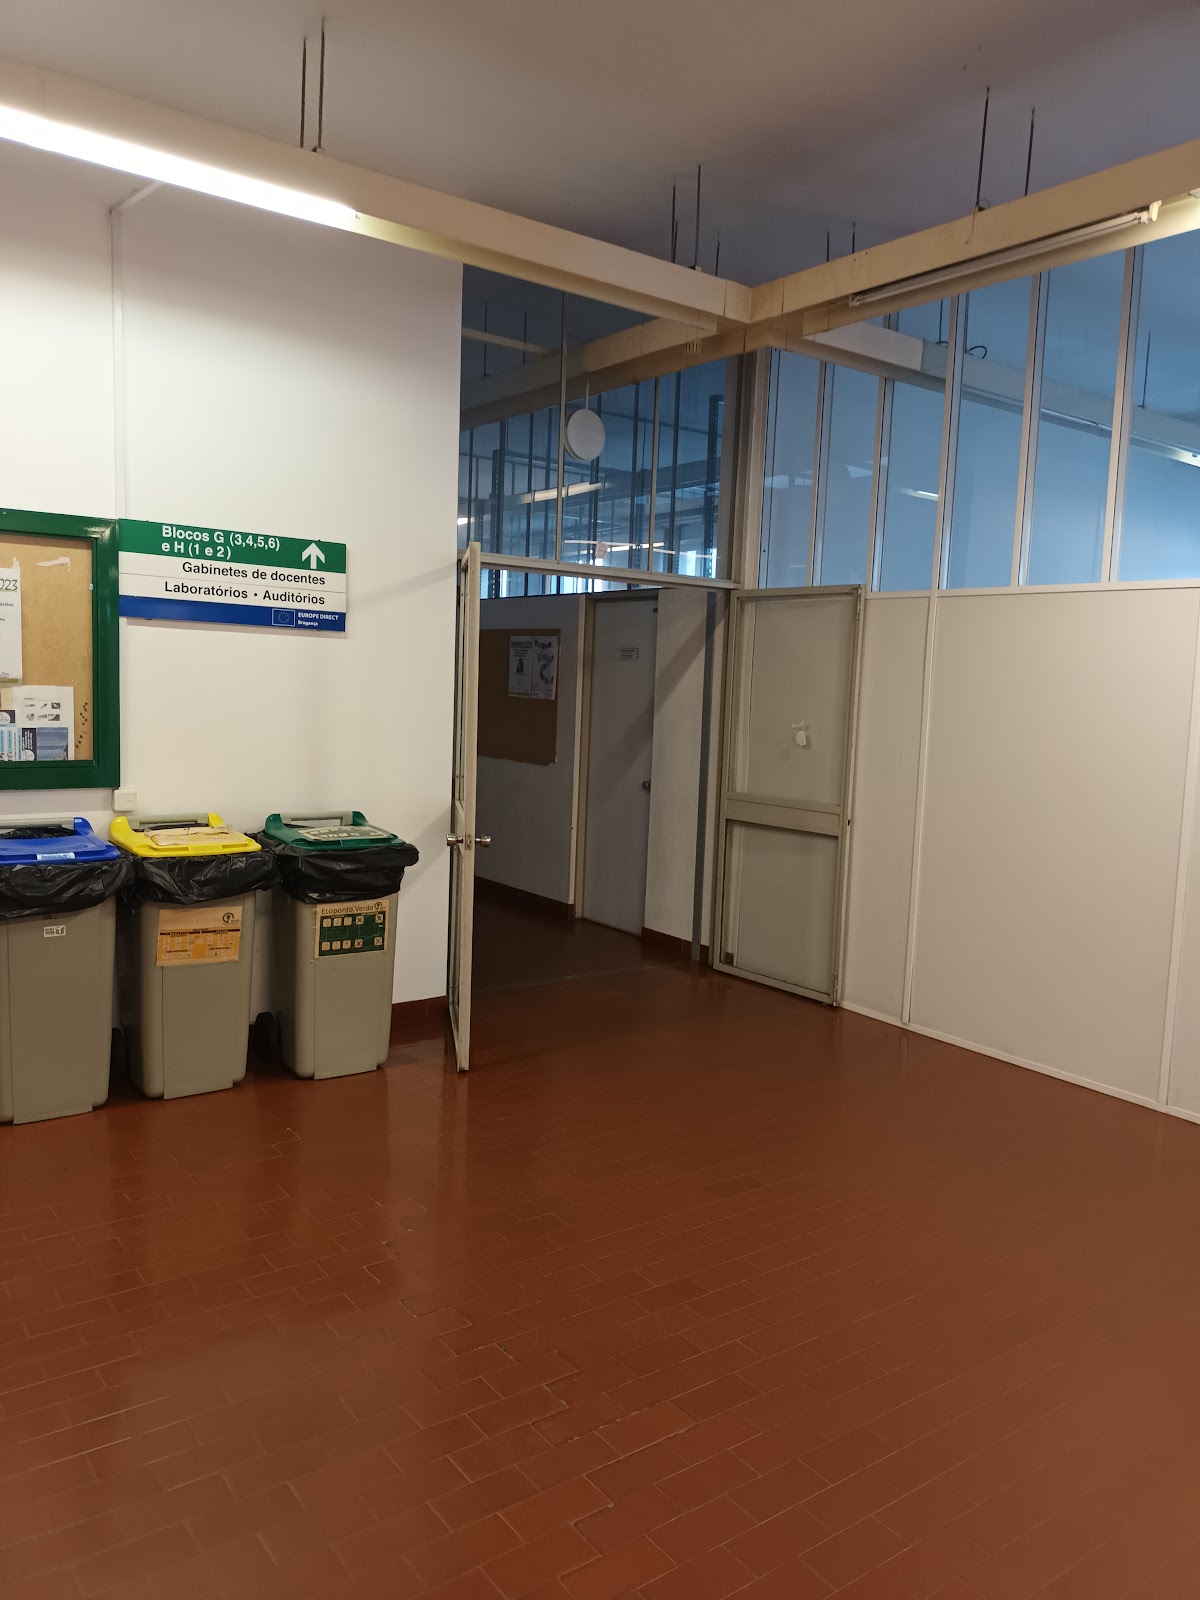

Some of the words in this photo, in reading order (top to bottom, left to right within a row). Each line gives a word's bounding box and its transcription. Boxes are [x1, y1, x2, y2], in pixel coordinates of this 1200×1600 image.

[162, 525, 209, 542] Blocos
[214, 531, 224, 543] G
[230, 532, 280, 552] (3,4,5,6)
[161, 542, 170, 552] e
[174, 541, 184, 553] H
[204, 546, 213, 556] e
[182, 561, 247, 578] Gabinetes
[252, 569, 267, 580] de
[270, 570, 326, 585] docentes
[165, 581, 248, 598] Laboratórios
[262, 590, 325, 605] Auditórios
[298, 611, 319, 619] EUROPE
[321, 907, 354, 915] Ecoponto
